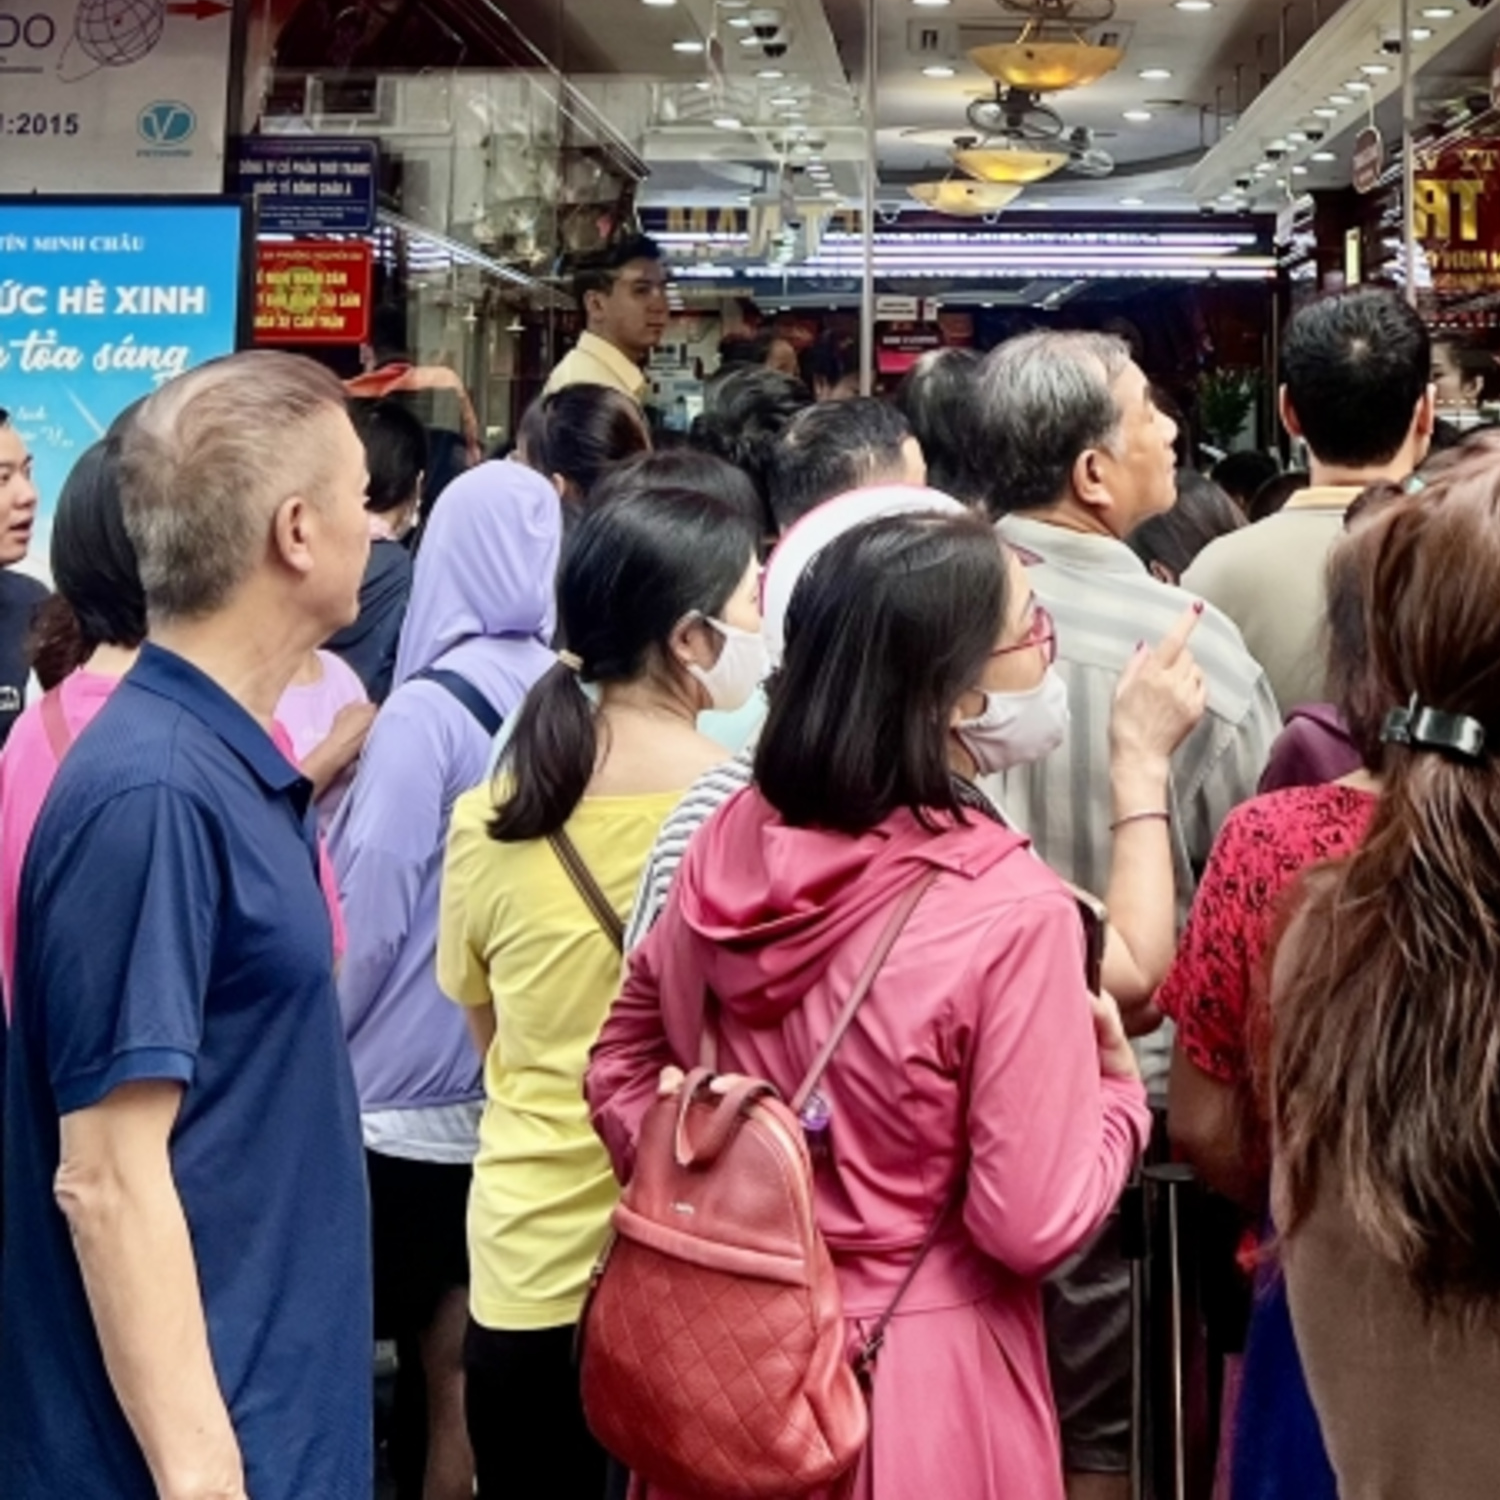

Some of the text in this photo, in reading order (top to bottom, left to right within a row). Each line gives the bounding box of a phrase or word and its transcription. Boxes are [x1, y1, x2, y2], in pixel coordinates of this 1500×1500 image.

[33, 235, 86, 251] MINH
[89, 233, 145, 251] CHÂU
[57, 279, 106, 315] HÈ
[113, 285, 206, 315] XINH
